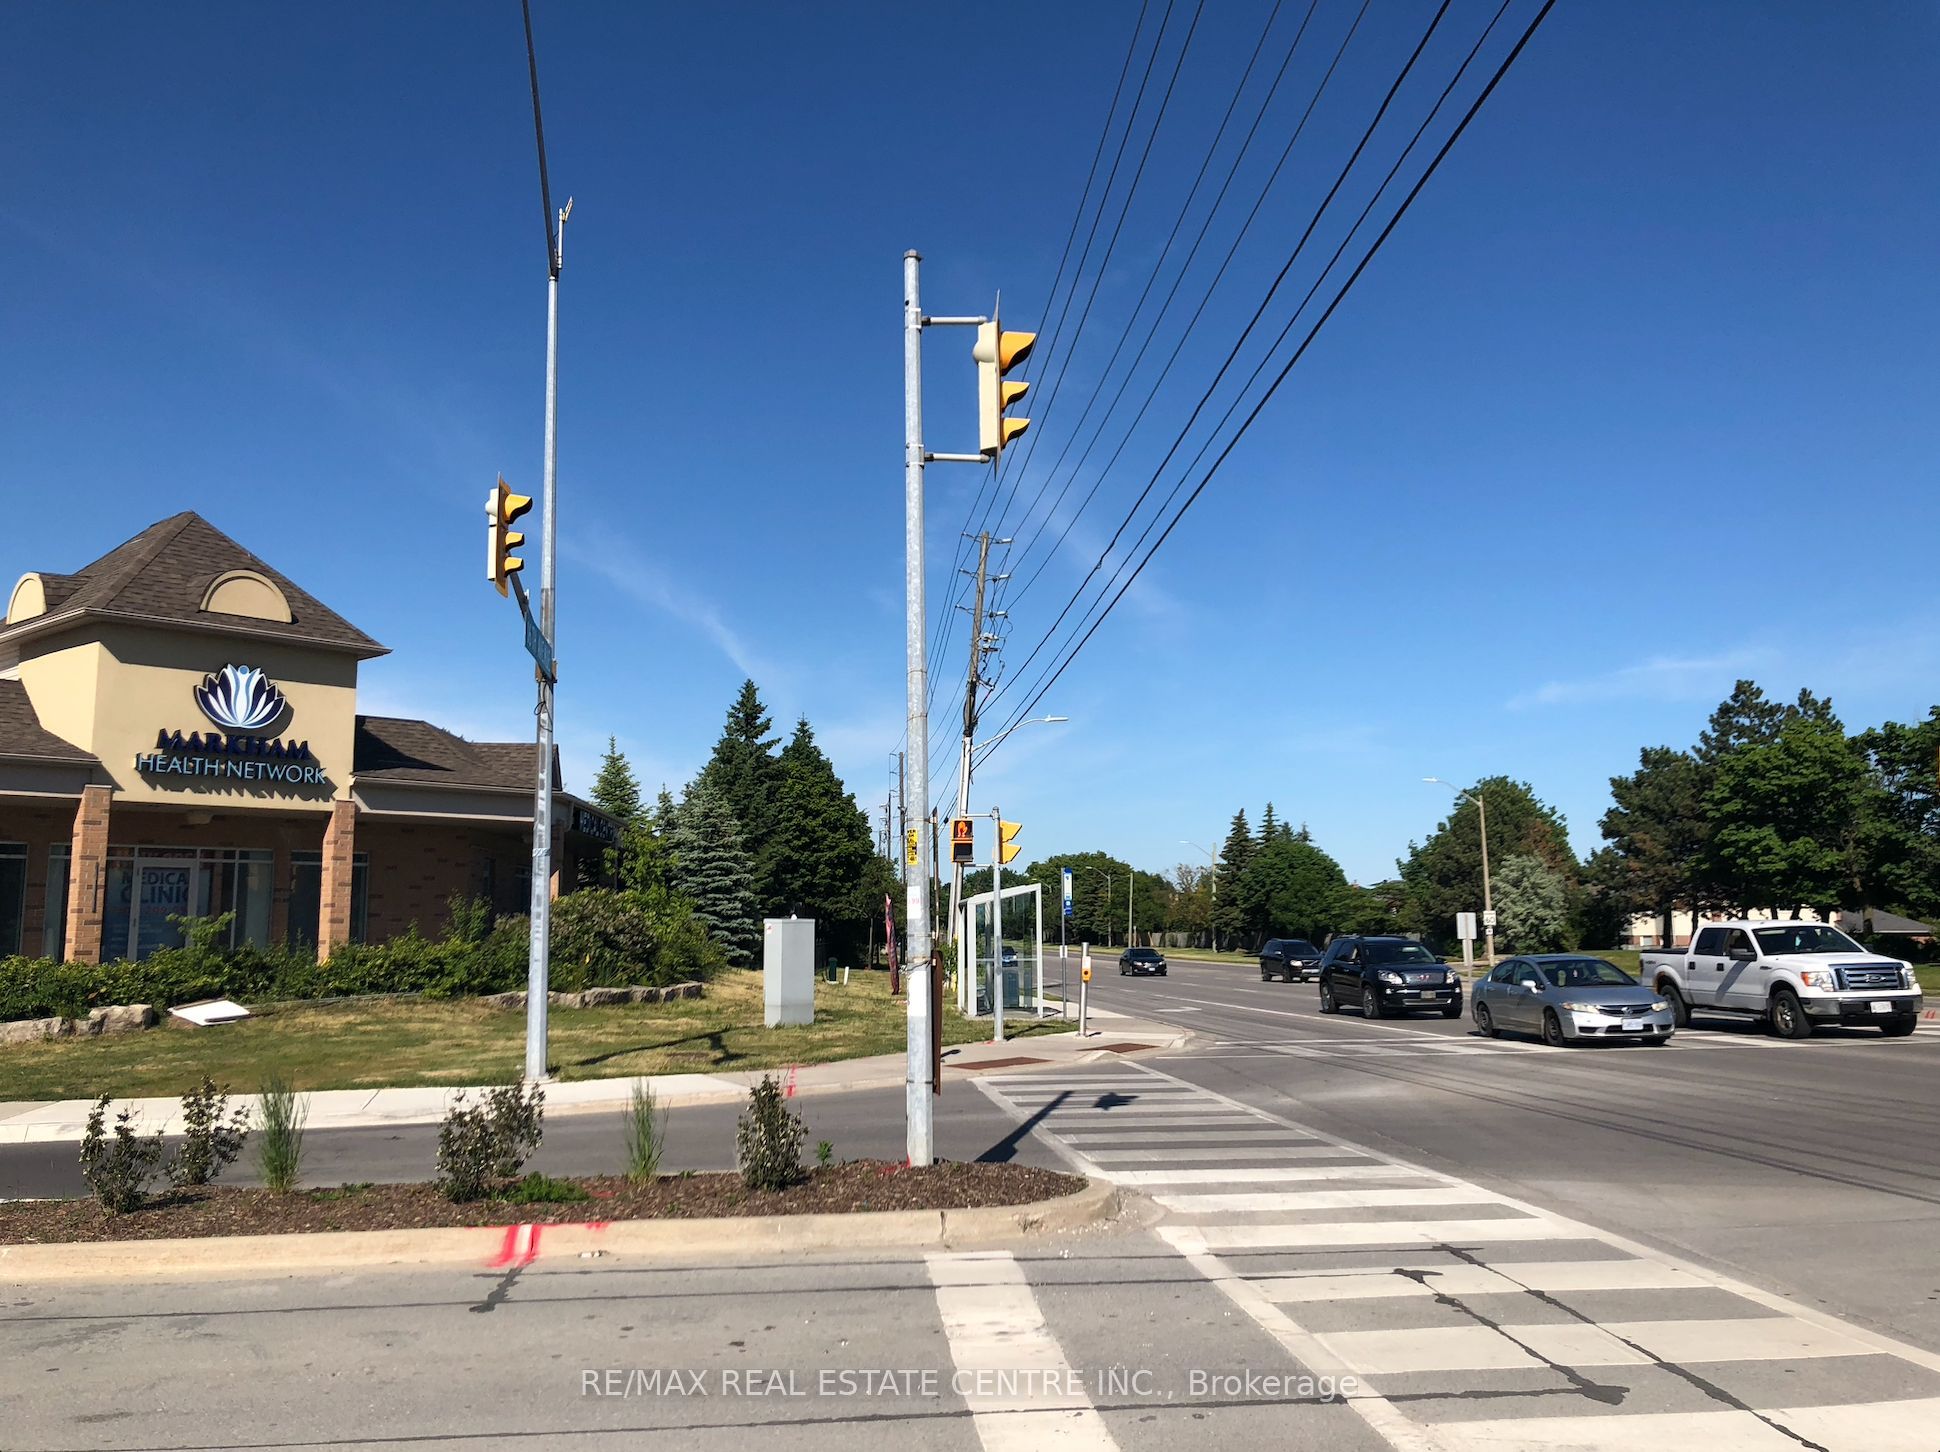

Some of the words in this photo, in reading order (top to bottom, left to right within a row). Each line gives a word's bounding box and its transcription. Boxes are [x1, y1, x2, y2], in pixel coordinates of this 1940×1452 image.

[155, 728, 312, 760] MARKHAM
[137, 754, 219, 777] HEALTH
[226, 760, 327, 785] NETWORK
[120, 871, 189, 885] MEDICA
